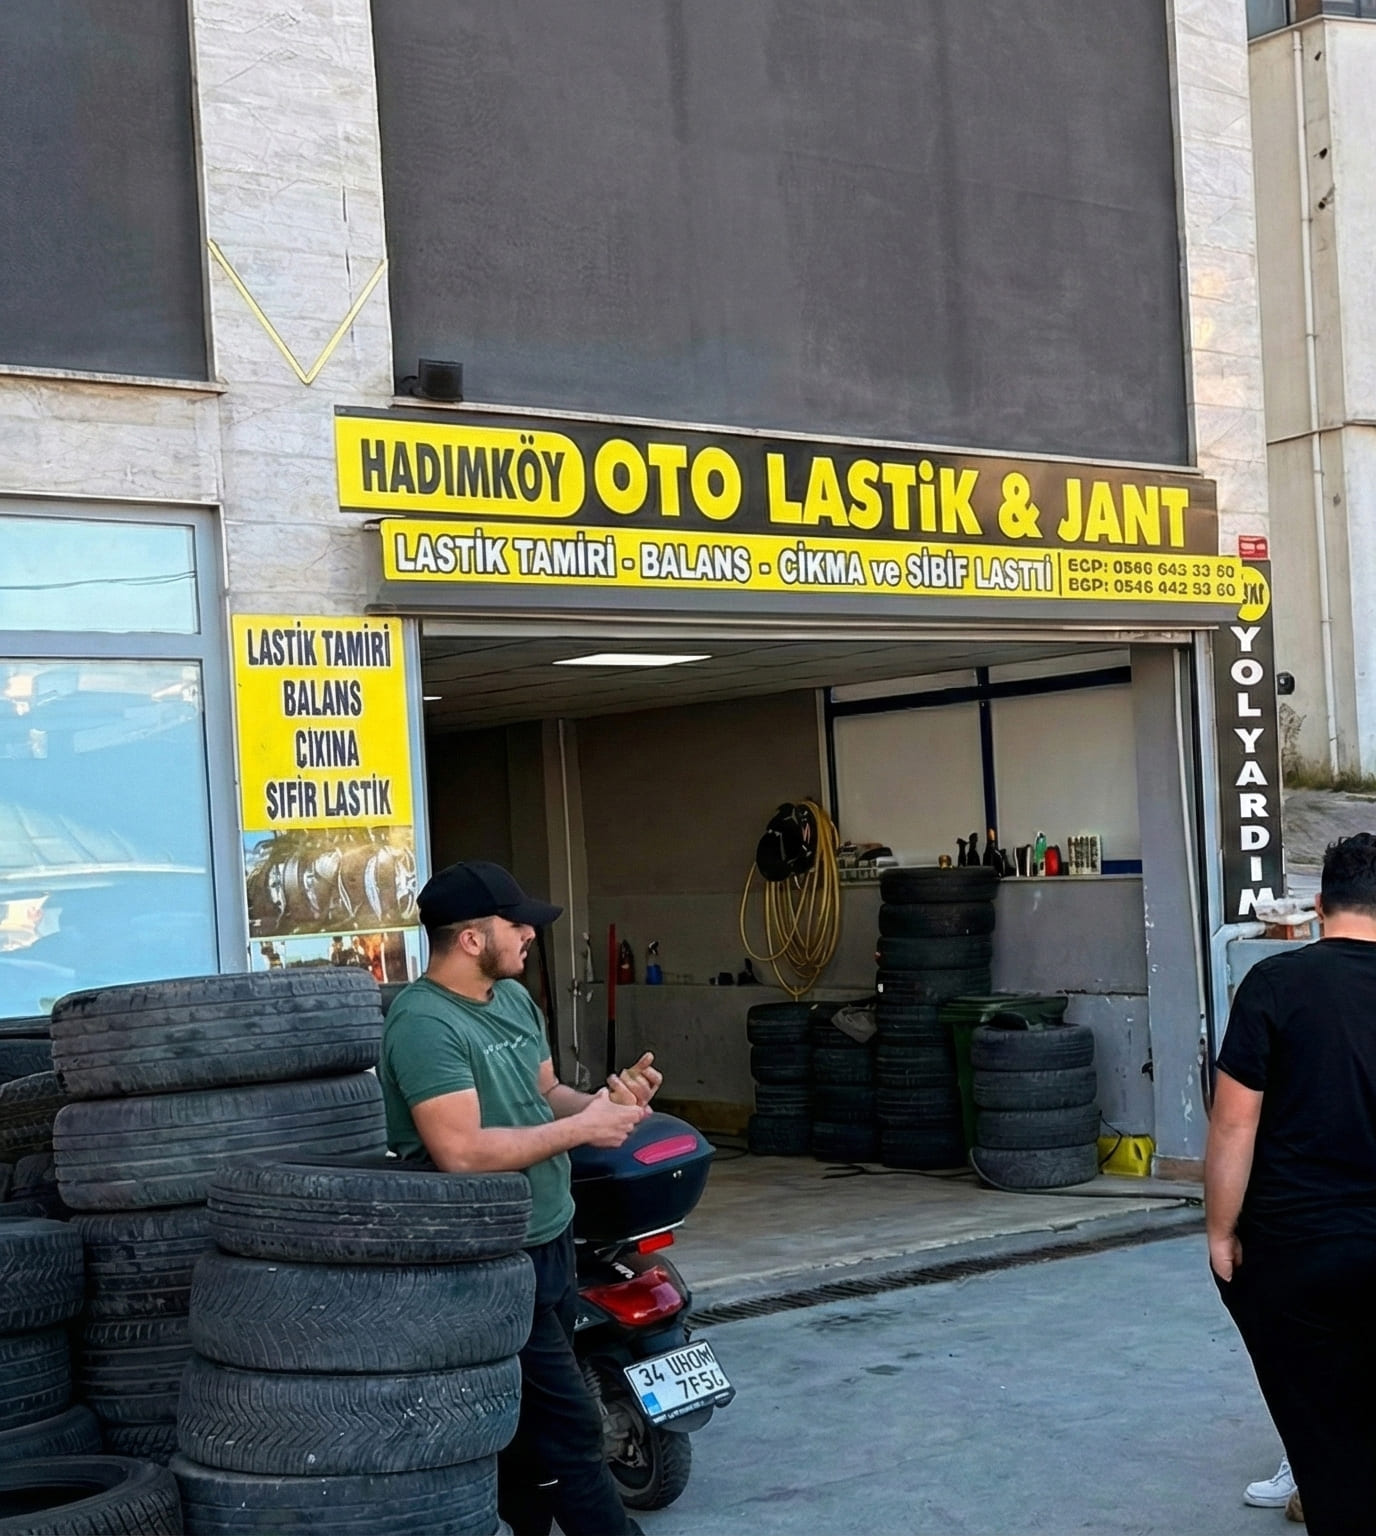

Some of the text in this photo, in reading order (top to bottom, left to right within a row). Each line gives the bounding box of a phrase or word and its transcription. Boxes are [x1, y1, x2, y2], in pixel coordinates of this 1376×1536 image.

[361, 433, 565, 502] HADIMKÖY
[594, 438, 742, 520] OTO
[998, 472, 1043, 539] &
[1057, 478, 1190, 547] JANT
[395, 528, 508, 574] LASTİK
[512, 531, 617, 577] TAMİRİ
[640, 543, 750, 583] BALANS
[870, 560, 901, 587] ve
[247, 621, 391, 667] LASTİK TAMİRİ
[283, 679, 362, 716] BALANS
[323, 773, 392, 816] LASTİK
[638, 1364, 665, 1387] 34
